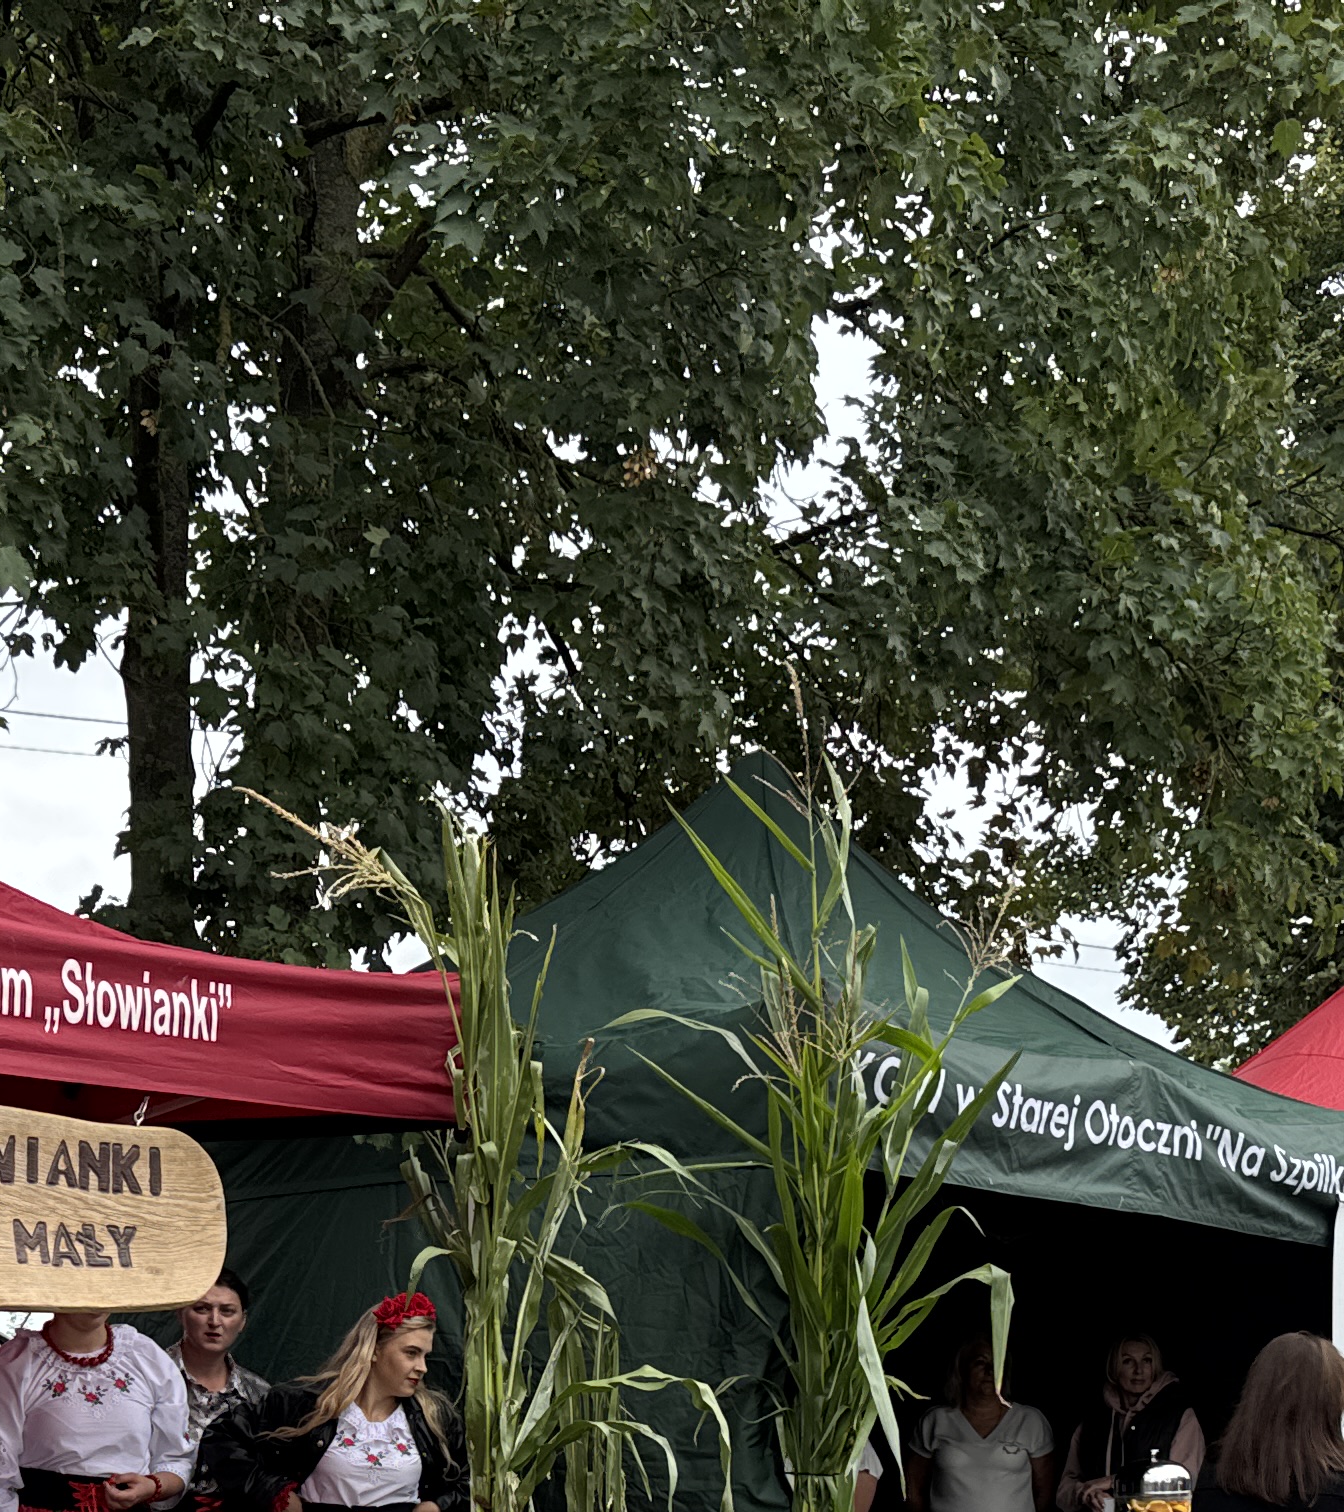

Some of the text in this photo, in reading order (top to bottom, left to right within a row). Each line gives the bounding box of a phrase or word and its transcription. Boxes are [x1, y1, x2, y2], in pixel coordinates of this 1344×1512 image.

[992, 1081, 1081, 1151] Starej
[1085, 1100, 1202, 1161] Otoczni
[1206, 1124, 1266, 1178] "Na
[13, 1219, 137, 1268] MAŁY
